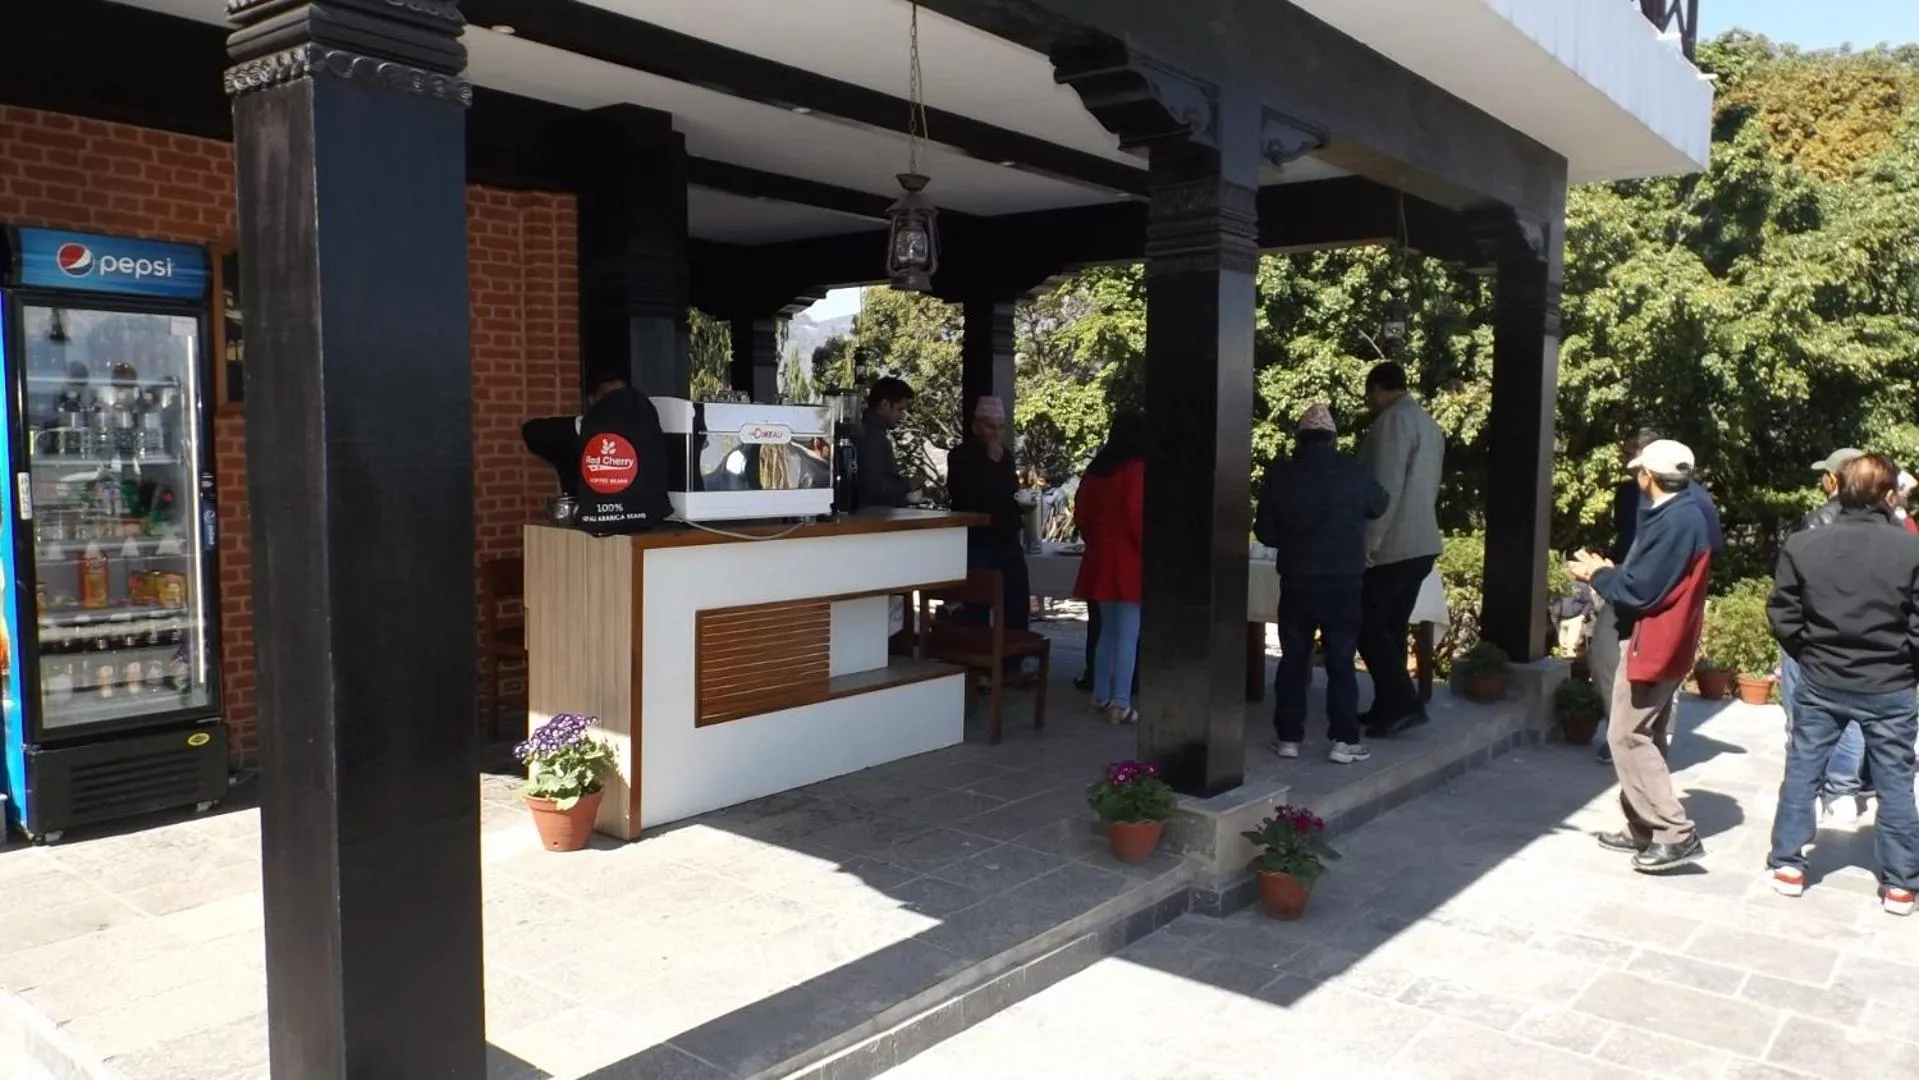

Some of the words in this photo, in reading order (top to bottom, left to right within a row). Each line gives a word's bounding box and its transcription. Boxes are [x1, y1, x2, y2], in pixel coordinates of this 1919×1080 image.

[100, 255, 172, 279] pepsi
[586, 455, 601, 464] Red
[602, 456, 633, 469] Cherry
[596, 503, 624, 513] 100%
